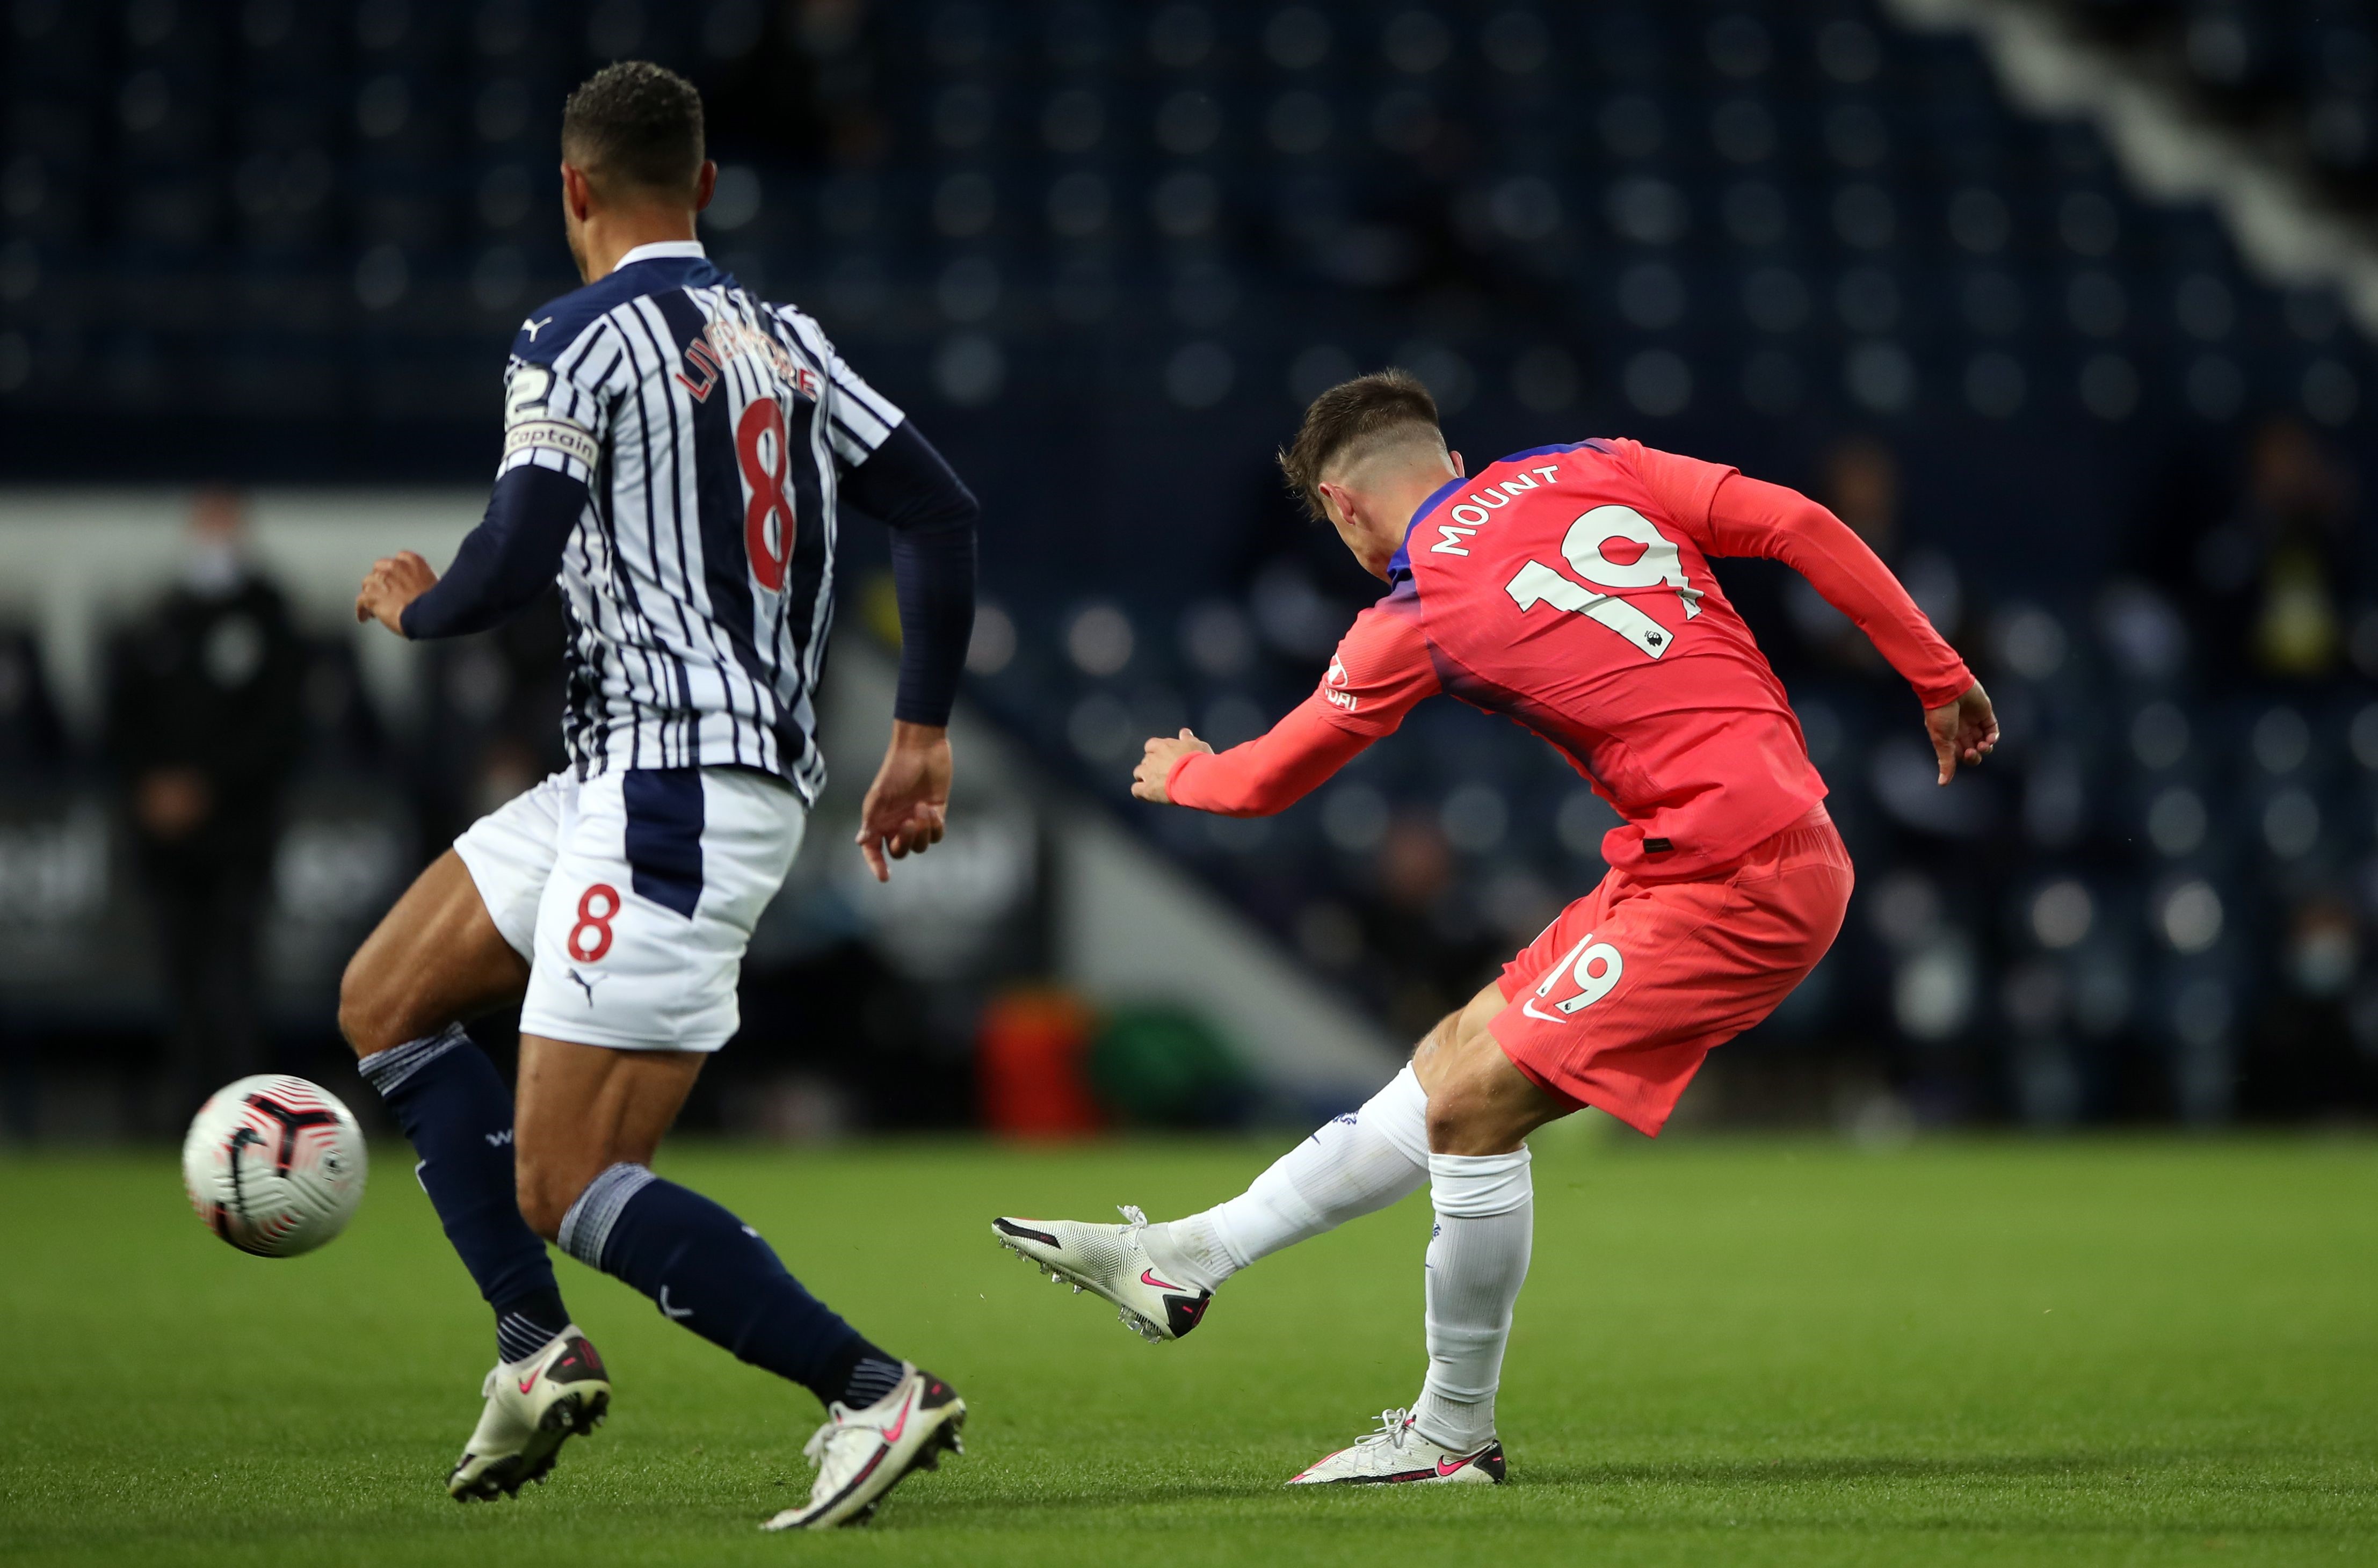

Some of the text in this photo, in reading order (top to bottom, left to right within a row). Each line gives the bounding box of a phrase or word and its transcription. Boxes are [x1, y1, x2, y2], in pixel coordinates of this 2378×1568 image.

[737, 397, 796, 592] 8
[1431, 464, 1560, 557] MOUNT
[1505, 505, 1705, 659] 19
[568, 883, 620, 961] 8
[1535, 933, 1624, 1014] 19
